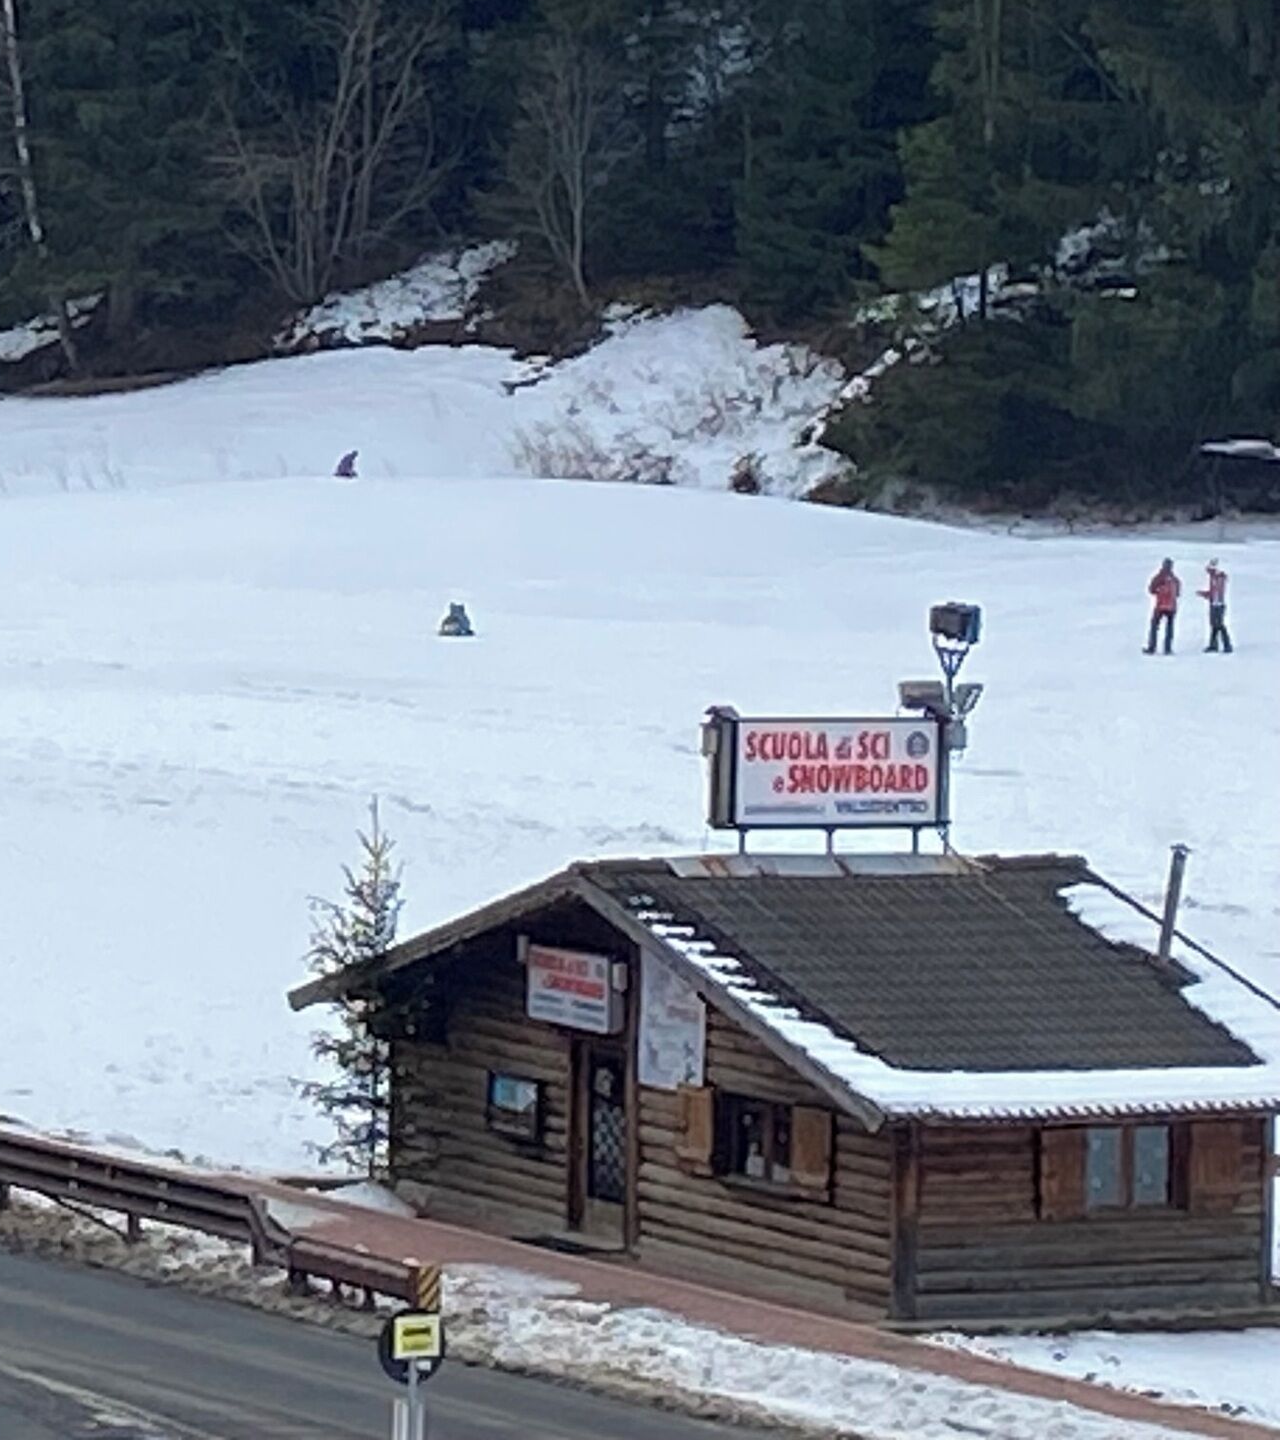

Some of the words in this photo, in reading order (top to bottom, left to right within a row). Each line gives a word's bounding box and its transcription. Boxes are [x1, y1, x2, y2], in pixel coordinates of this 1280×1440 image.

[745, 731, 829, 761] SCUOLA
[856, 731, 891, 759] SCI
[787, 764, 929, 794] SNOWBOARD
